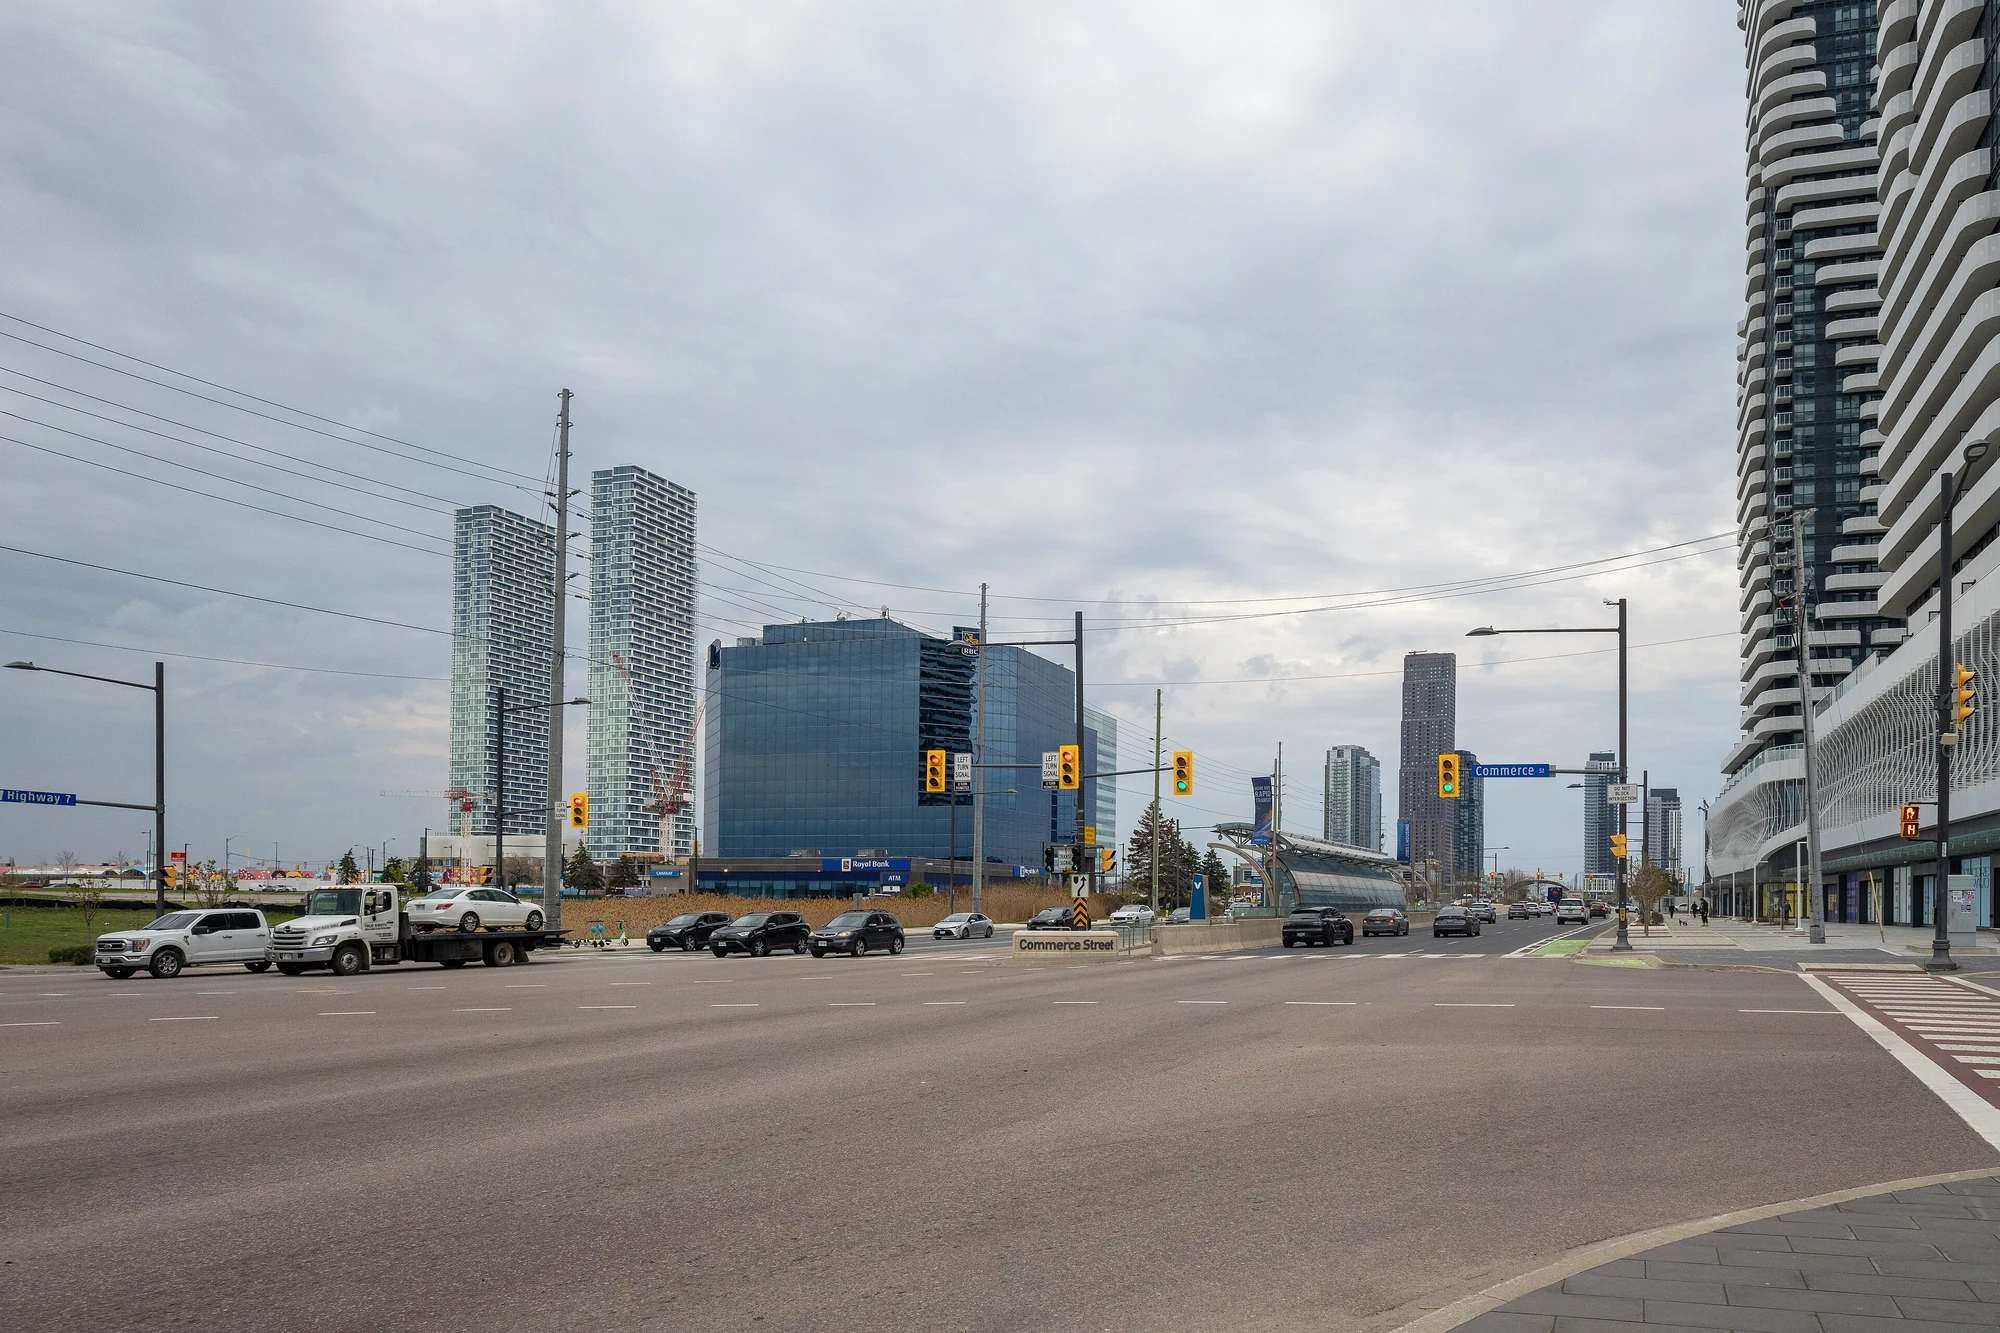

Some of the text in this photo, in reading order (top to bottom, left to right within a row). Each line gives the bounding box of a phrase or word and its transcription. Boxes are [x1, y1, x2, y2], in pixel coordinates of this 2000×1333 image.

[1475, 766, 1535, 776] Commerce
[7, 790, 71, 805] Highway 7
[852, 860, 871, 869] Royal
[1019, 939, 1114, 950] Commerce Street
